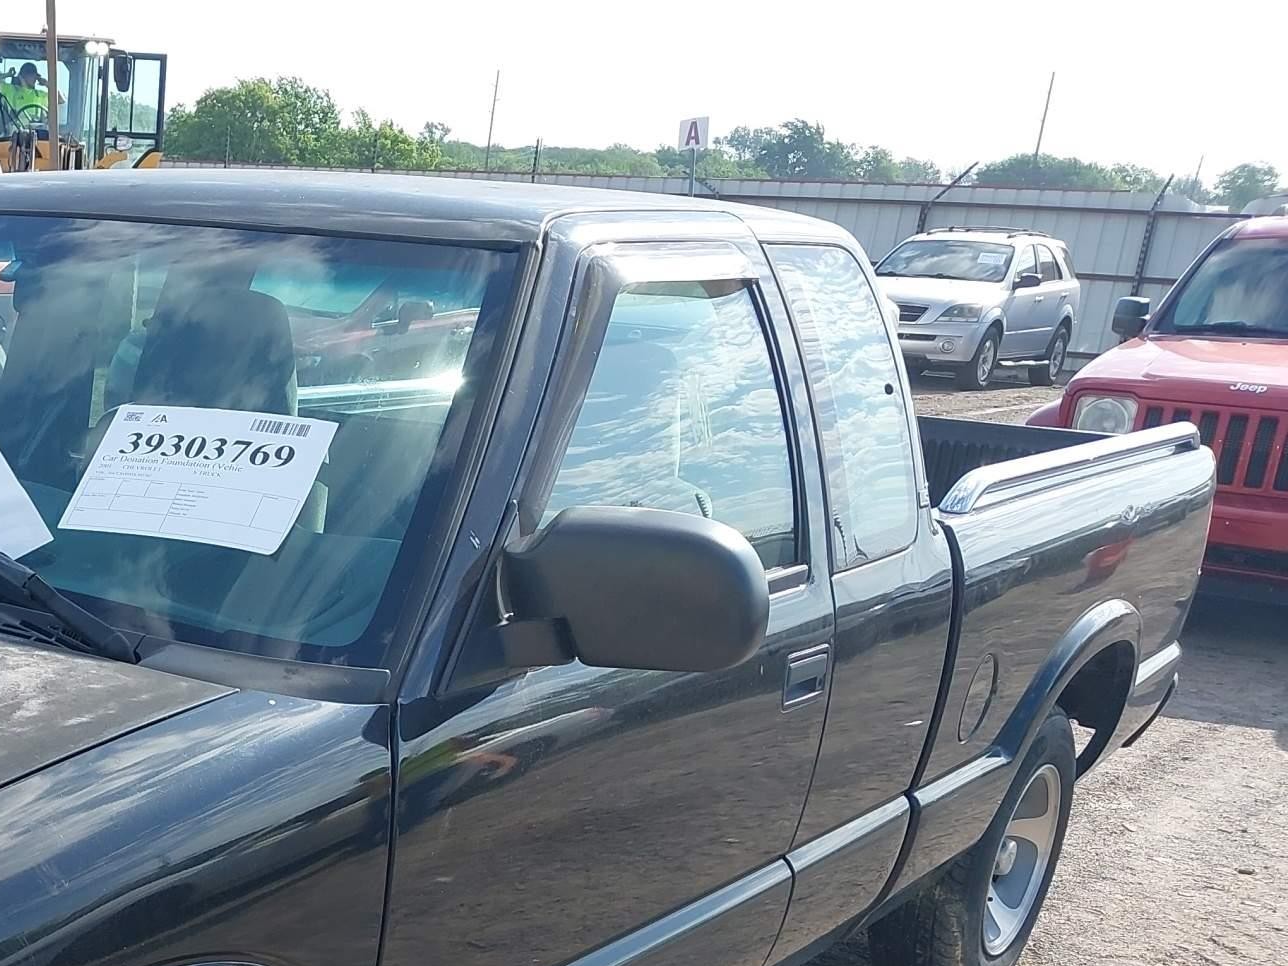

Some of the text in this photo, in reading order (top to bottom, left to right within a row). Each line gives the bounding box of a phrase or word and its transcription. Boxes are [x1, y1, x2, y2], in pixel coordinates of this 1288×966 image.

[685, 121, 700, 146] A
[1229, 382, 1268, 394] Jeep
[118, 432, 296, 468] 39303769
[102, 454, 119, 463] Car
[120, 455, 159, 465] Donation
[160, 457, 211, 469] Foundation
